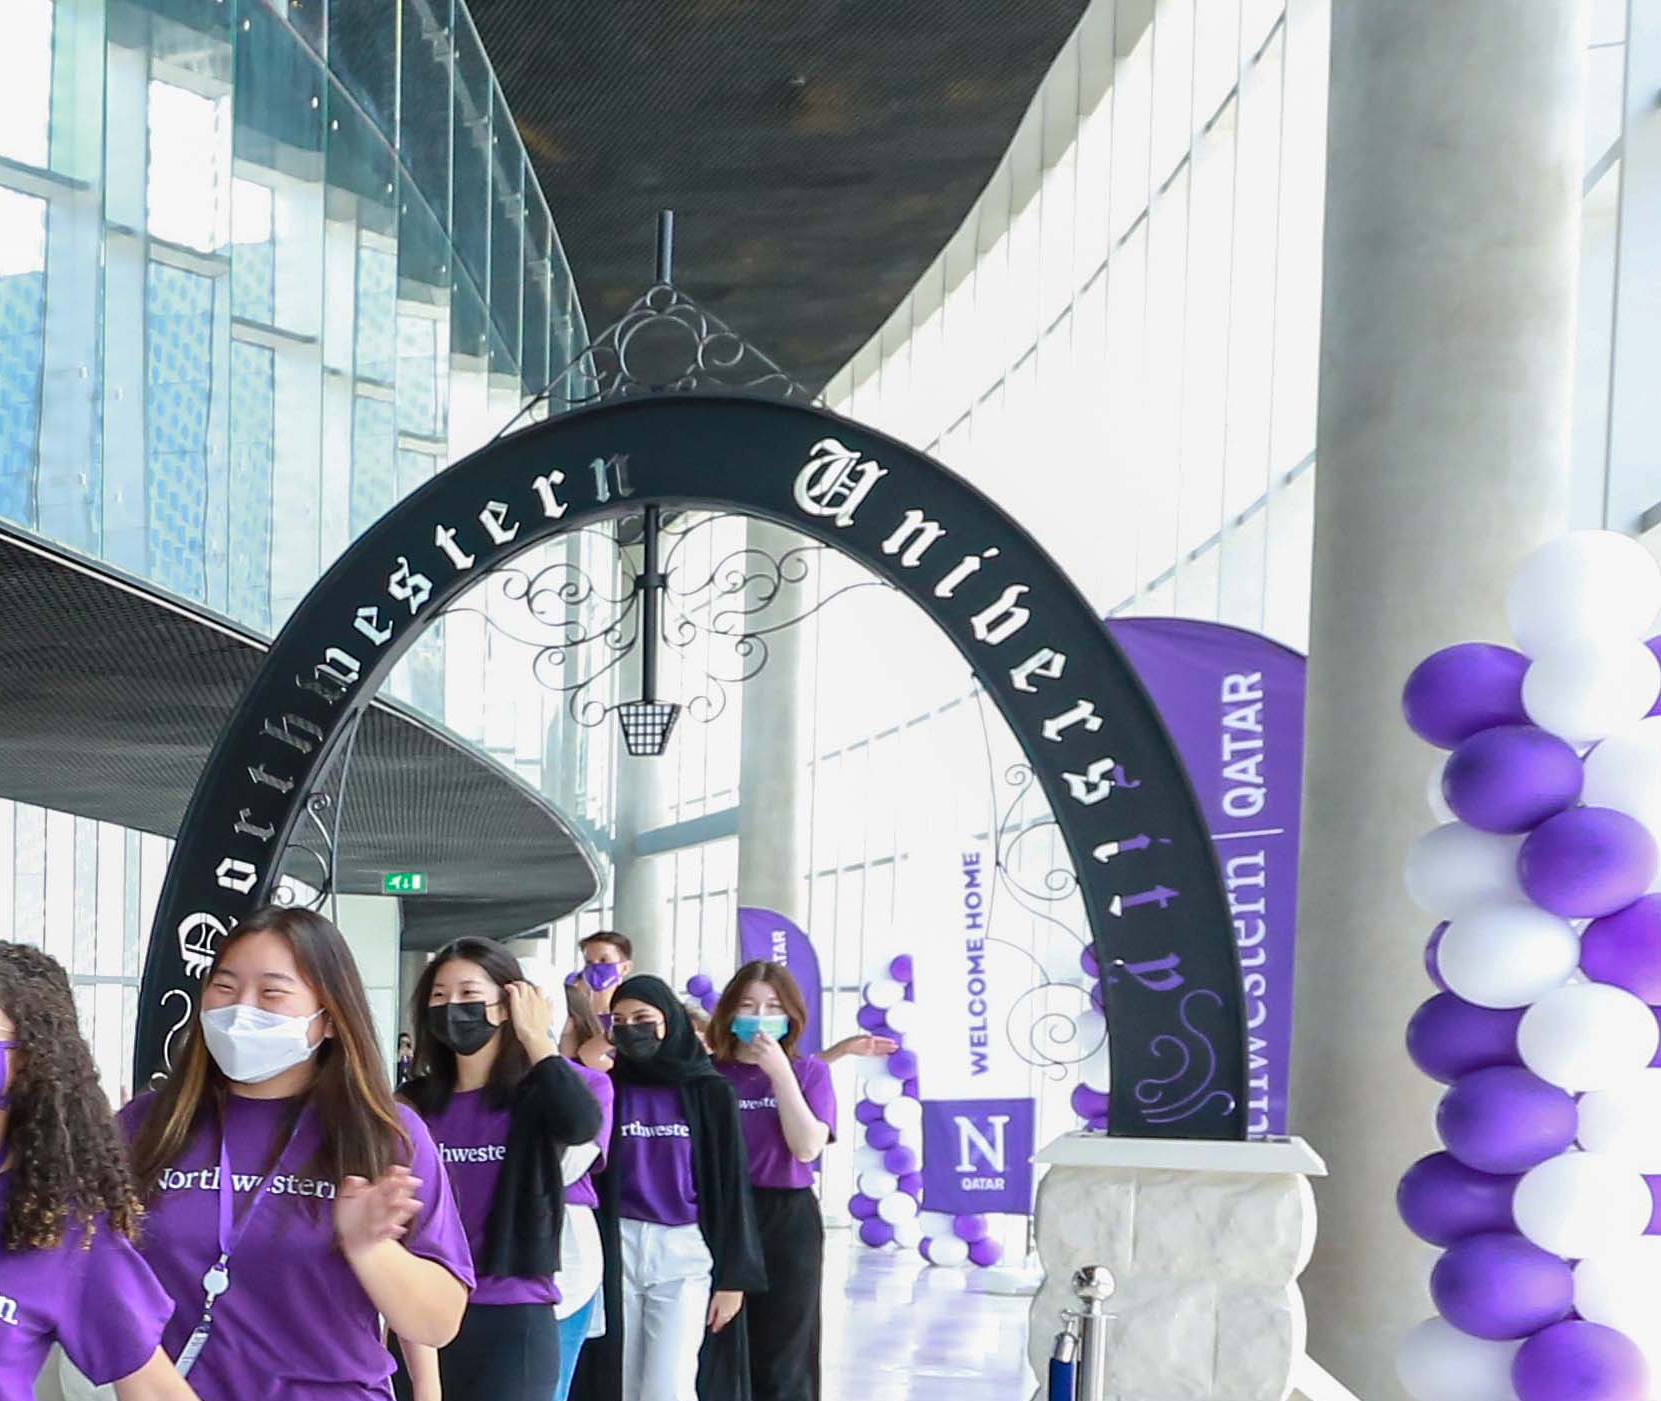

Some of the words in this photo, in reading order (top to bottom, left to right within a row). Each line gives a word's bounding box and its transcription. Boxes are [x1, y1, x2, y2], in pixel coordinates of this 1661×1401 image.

[178, 452, 631, 980] Northwestern
[792, 437, 1186, 993] University
[1221, 671, 1267, 818] QATAR
[962, 851, 983, 930] HOME
[965, 936, 989, 1077] WELCOME
[953, 1115, 1011, 1173] N
[961, 1177, 1005, 1191] QATAR
